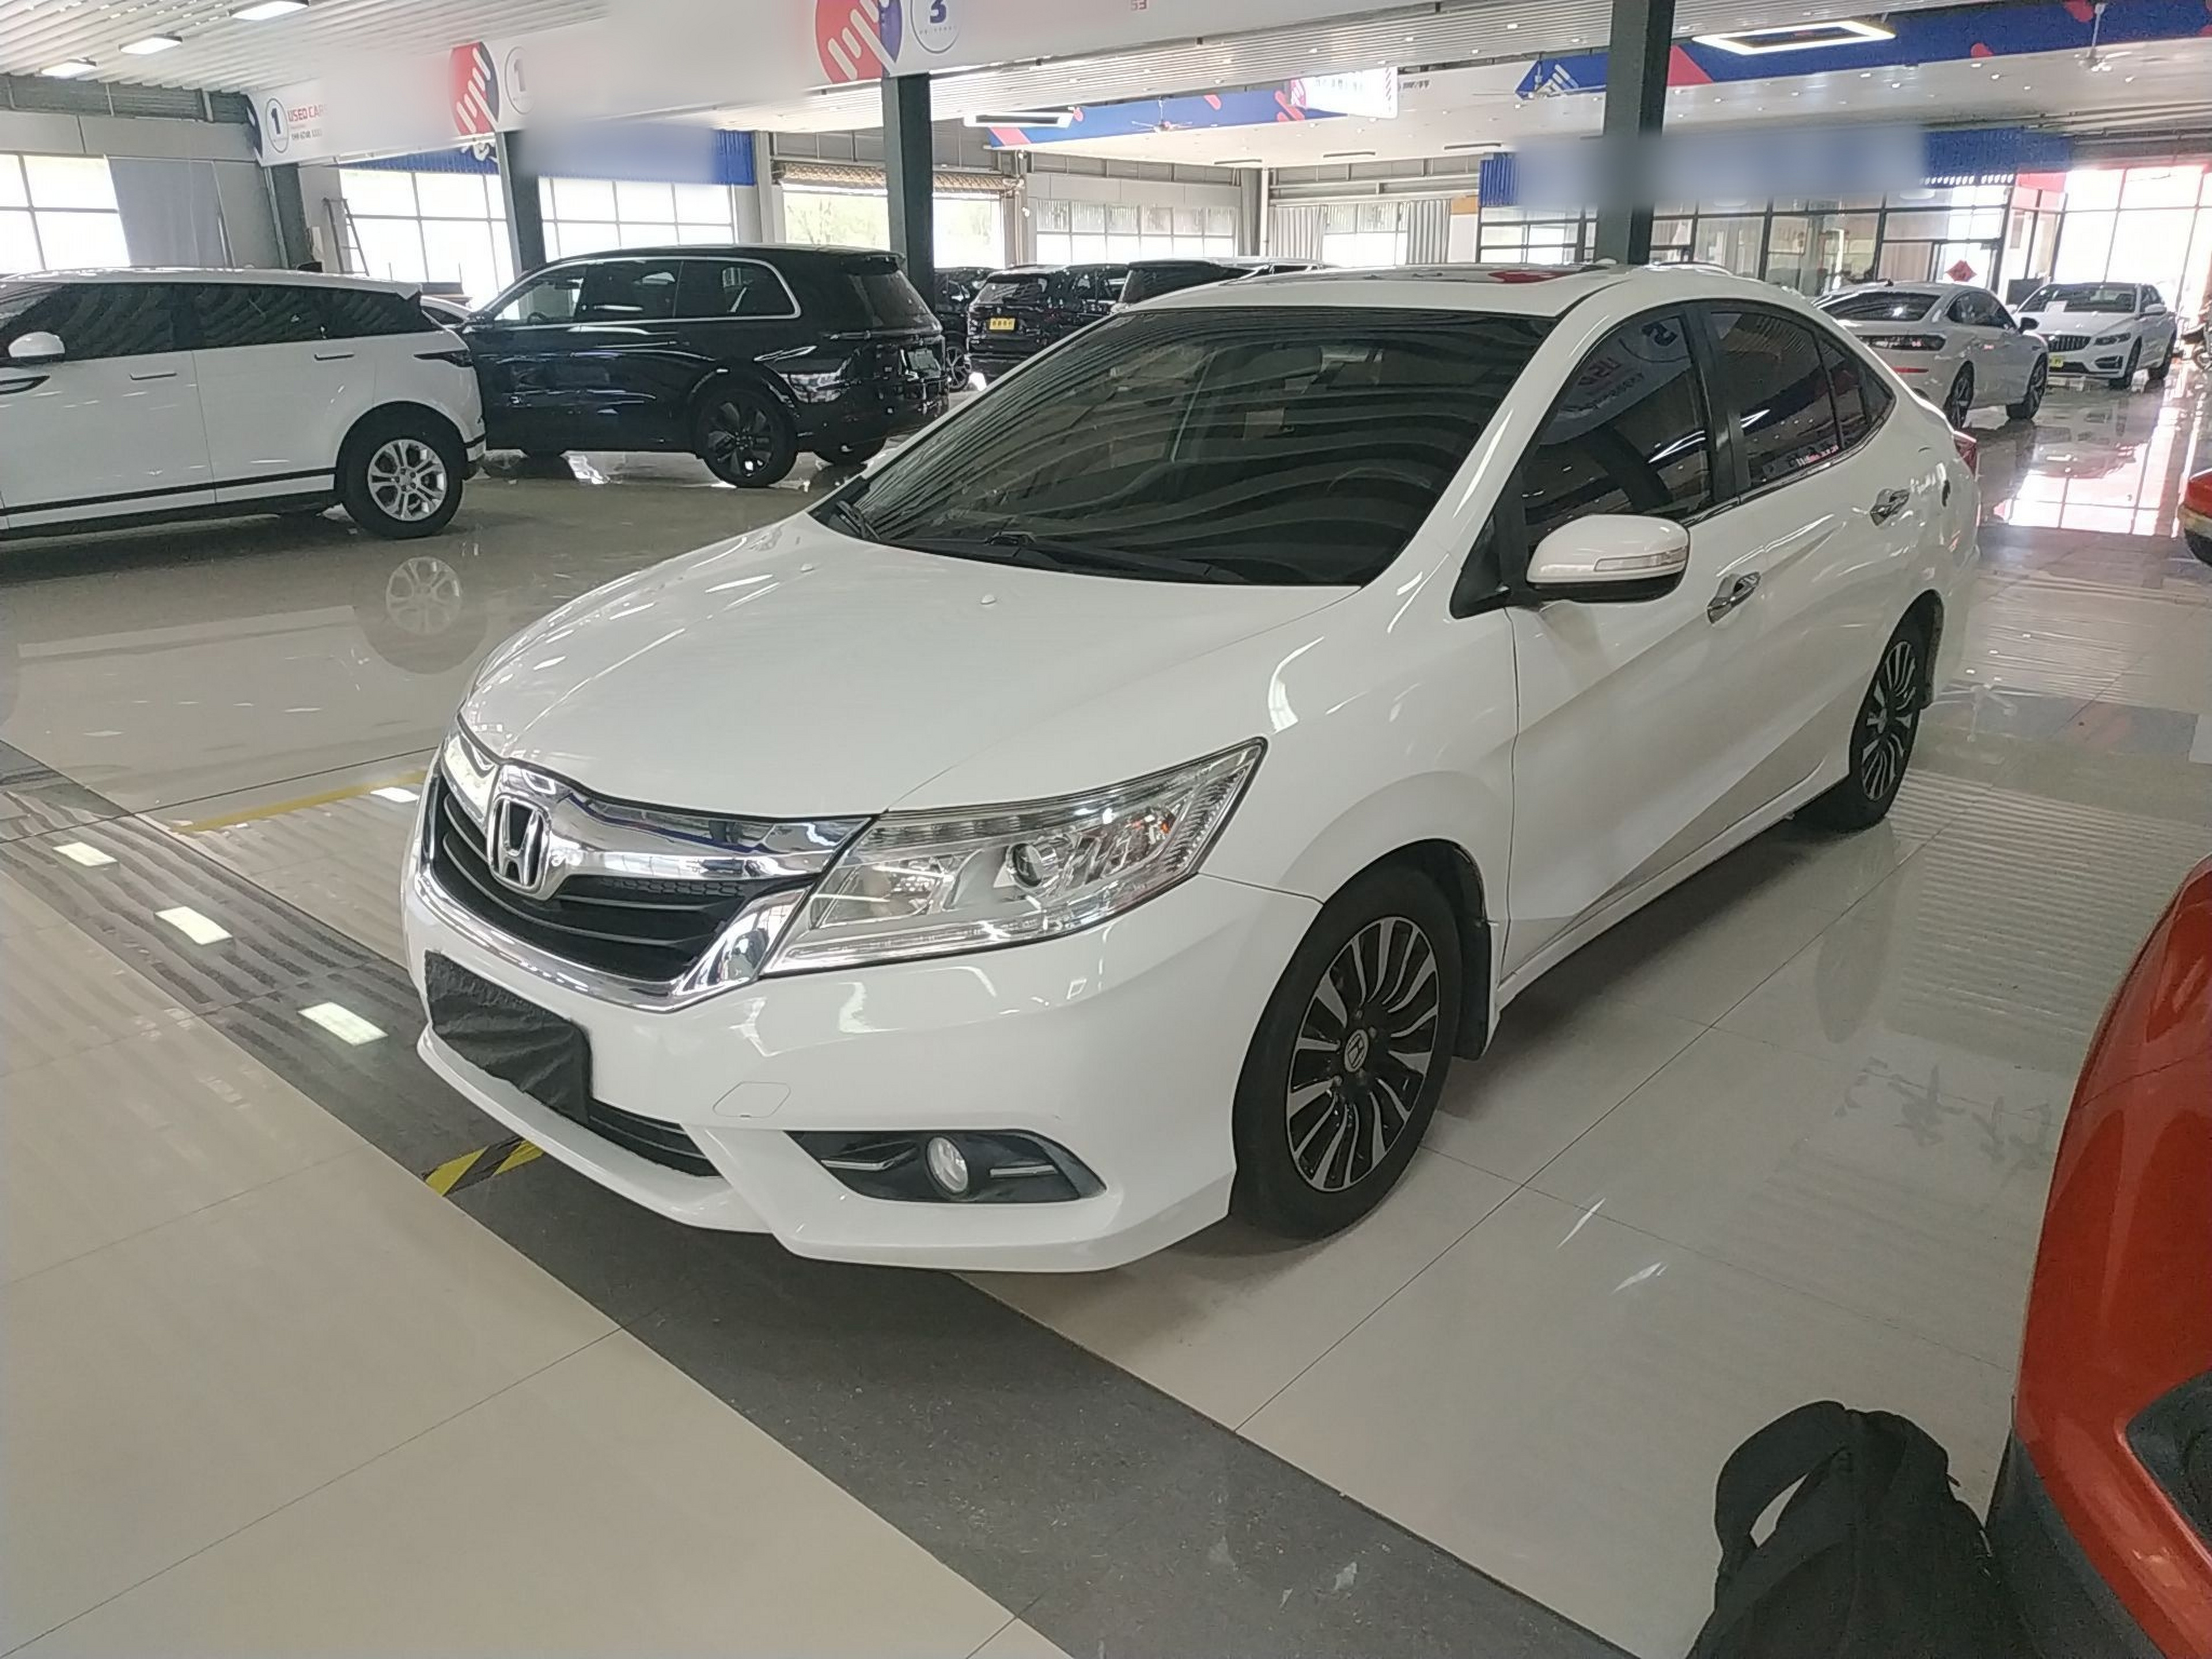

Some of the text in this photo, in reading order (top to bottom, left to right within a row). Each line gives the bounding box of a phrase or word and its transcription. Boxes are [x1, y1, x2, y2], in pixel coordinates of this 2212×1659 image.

[271, 108, 281, 134] 1
[288, 104, 327, 122] USED CAR
